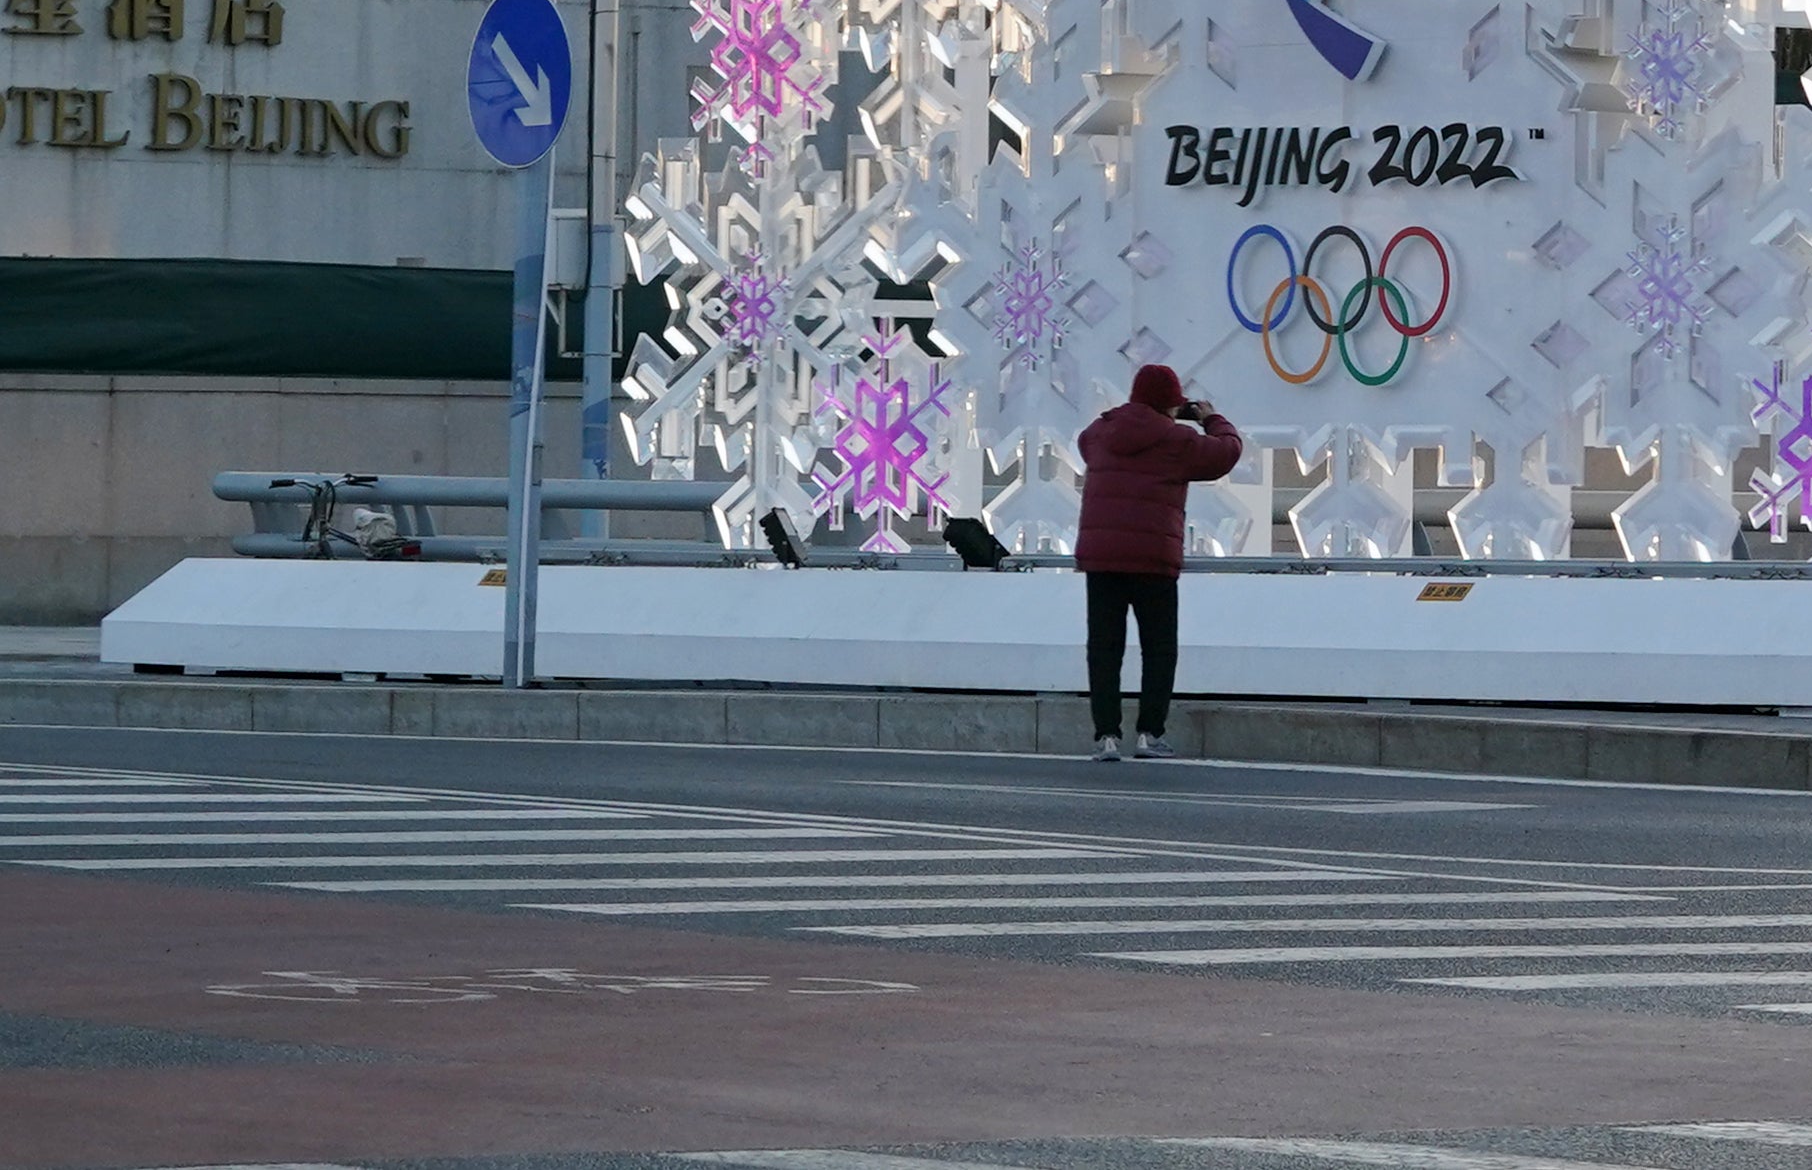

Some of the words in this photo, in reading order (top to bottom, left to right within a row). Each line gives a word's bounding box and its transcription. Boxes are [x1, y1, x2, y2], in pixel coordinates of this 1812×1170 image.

[0, 86, 130, 149] TEL
[145, 71, 413, 159] BEIJING
[1164, 124, 1351, 208] BEIJING
[1367, 122, 1520, 189] 2022
